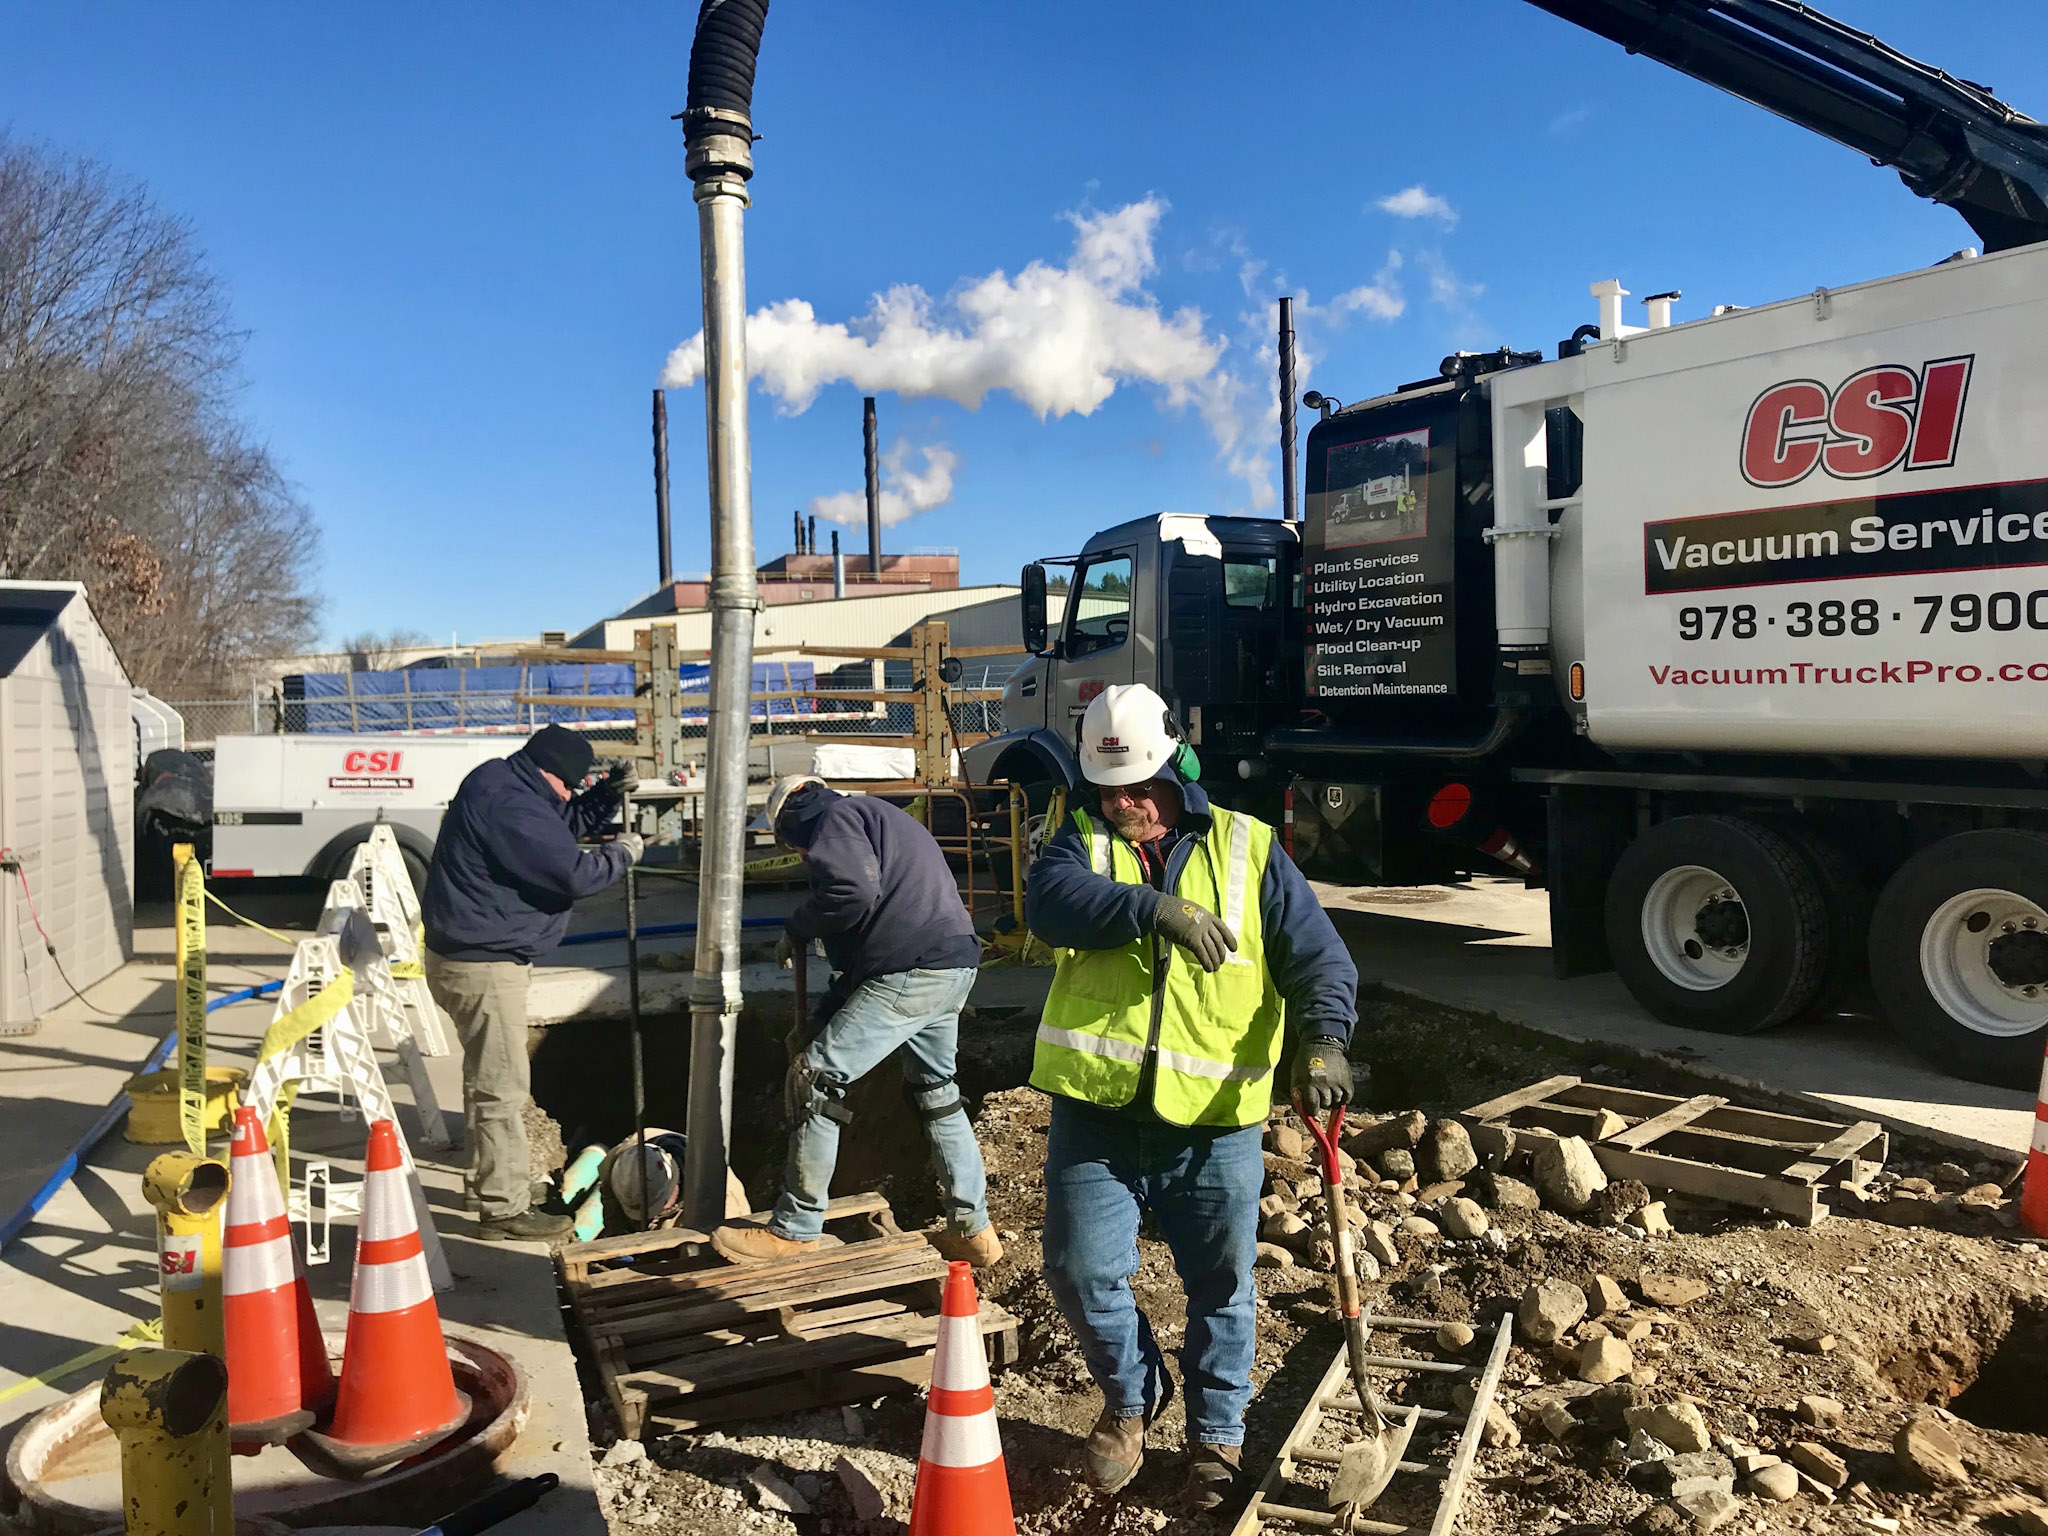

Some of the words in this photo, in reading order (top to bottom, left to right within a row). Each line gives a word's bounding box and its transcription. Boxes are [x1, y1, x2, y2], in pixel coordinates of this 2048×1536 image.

[1740, 354, 1975, 489] CSI
[1654, 528, 1839, 571] Vacuum
[1314, 561, 1351, 575] Plant
[1353, 553, 1419, 571] Services
[1314, 578, 1357, 594] Utility
[1359, 572, 1425, 589] Location
[1314, 601, 1356, 616] Hydro
[1359, 593, 1443, 609] Excavation
[1316, 622, 1343, 635] Wet
[1356, 618, 1381, 633] Dry
[1385, 615, 1444, 629] Vacuum
[1316, 642, 1353, 655] Flood
[1356, 639, 1421, 653] Clean-up
[1317, 664, 1341, 676] Silt
[1344, 661, 1406, 675] Removal
[1319, 684, 1371, 697] Detention
[1373, 682, 1448, 696] Maintenance
[1102, 736, 1119, 746] CSI
[343, 750, 403, 774] CSI
